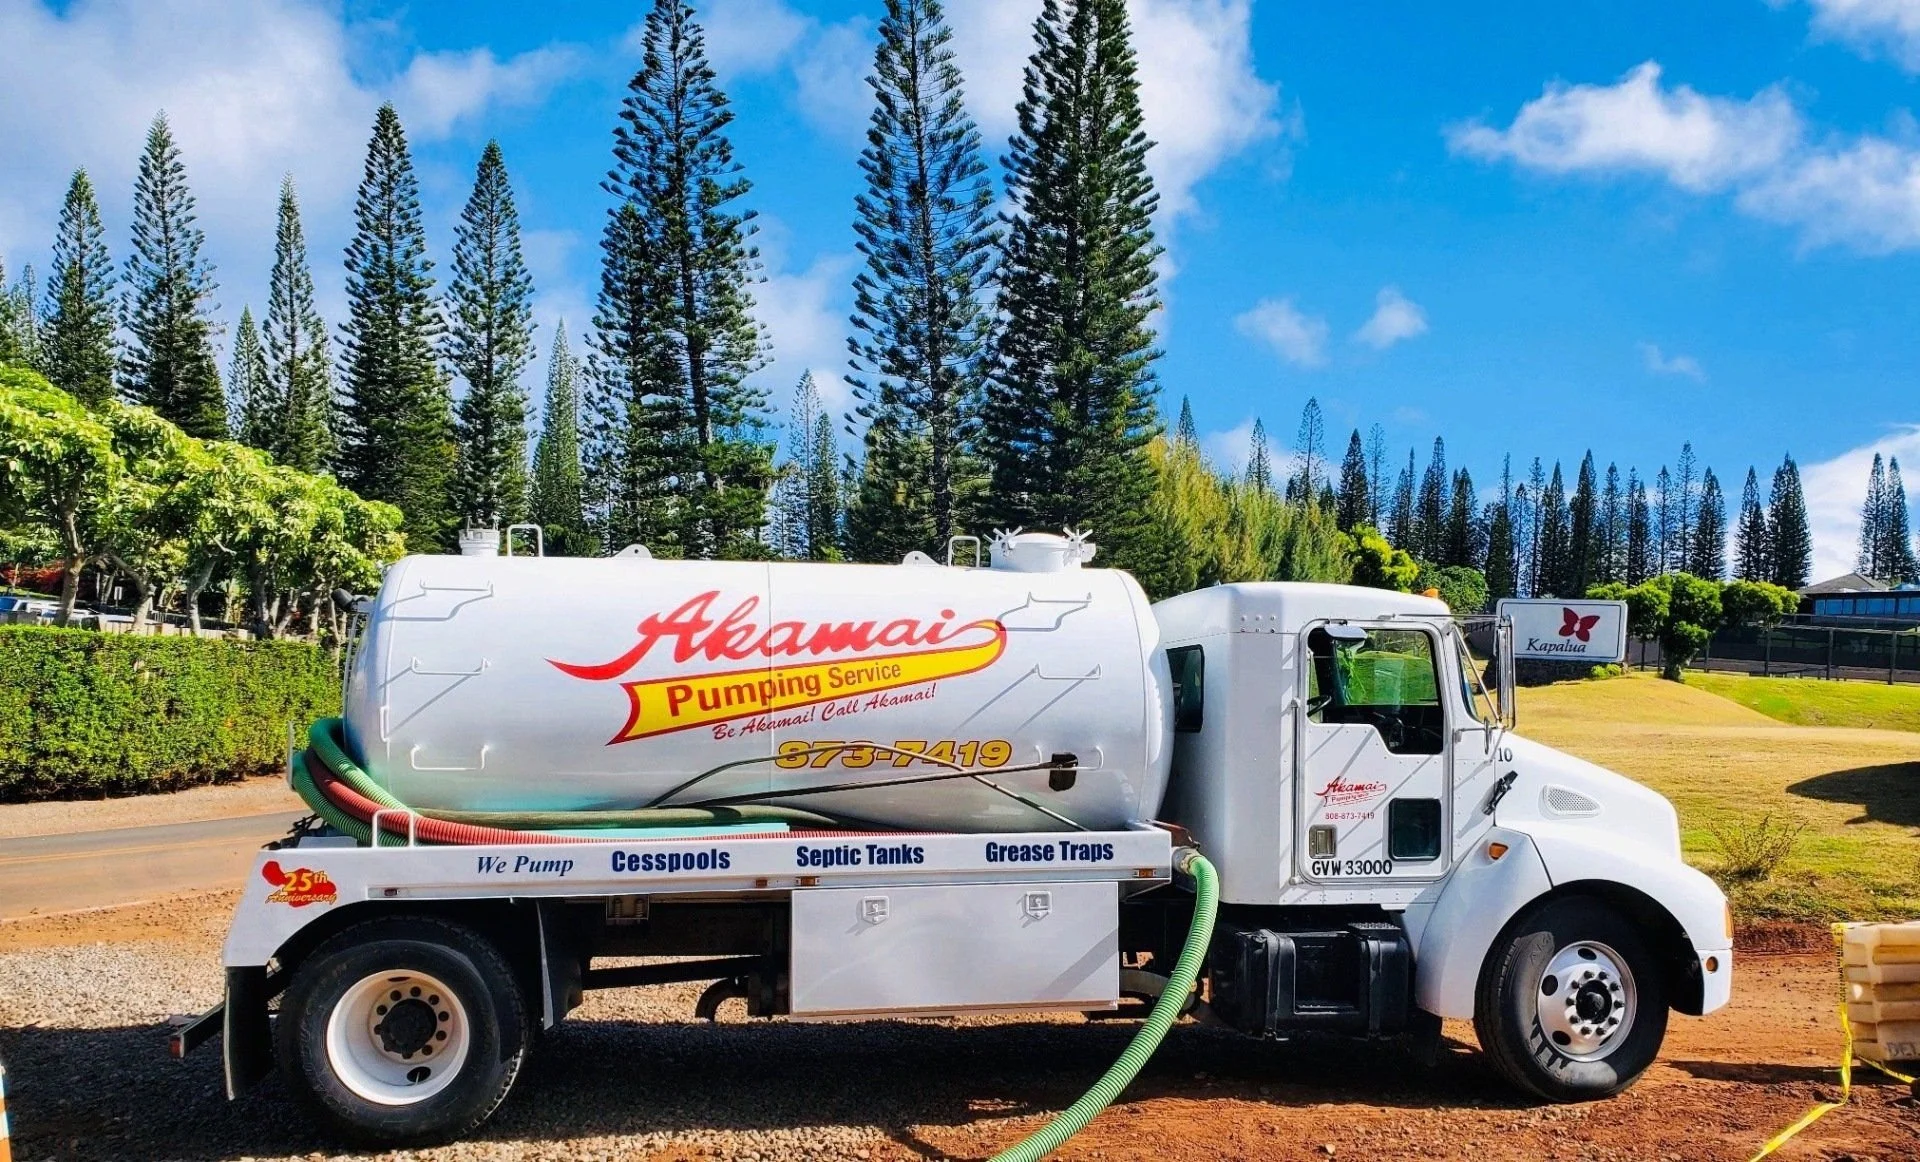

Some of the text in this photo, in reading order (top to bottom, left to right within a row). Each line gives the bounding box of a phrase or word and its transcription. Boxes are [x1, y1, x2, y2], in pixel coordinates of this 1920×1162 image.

[544, 589, 956, 680] Akamai
[1525, 637, 1587, 653] Kapalua
[666, 661, 902, 717] Pumping Service
[712, 682, 937, 740] Be Akamai! Call Akamai!
[774, 739, 1013, 769] 873-7419
[1497, 747, 1513, 762] 10
[1314, 775, 1379, 796] Akamai
[477, 840, 1114, 877] We Pump Cesspools Septic Tanks Grease Traps
[1311, 859, 1393, 876] GVW 33000
[282, 870, 328, 892] 25th
[265, 888, 338, 905] Anniversary
